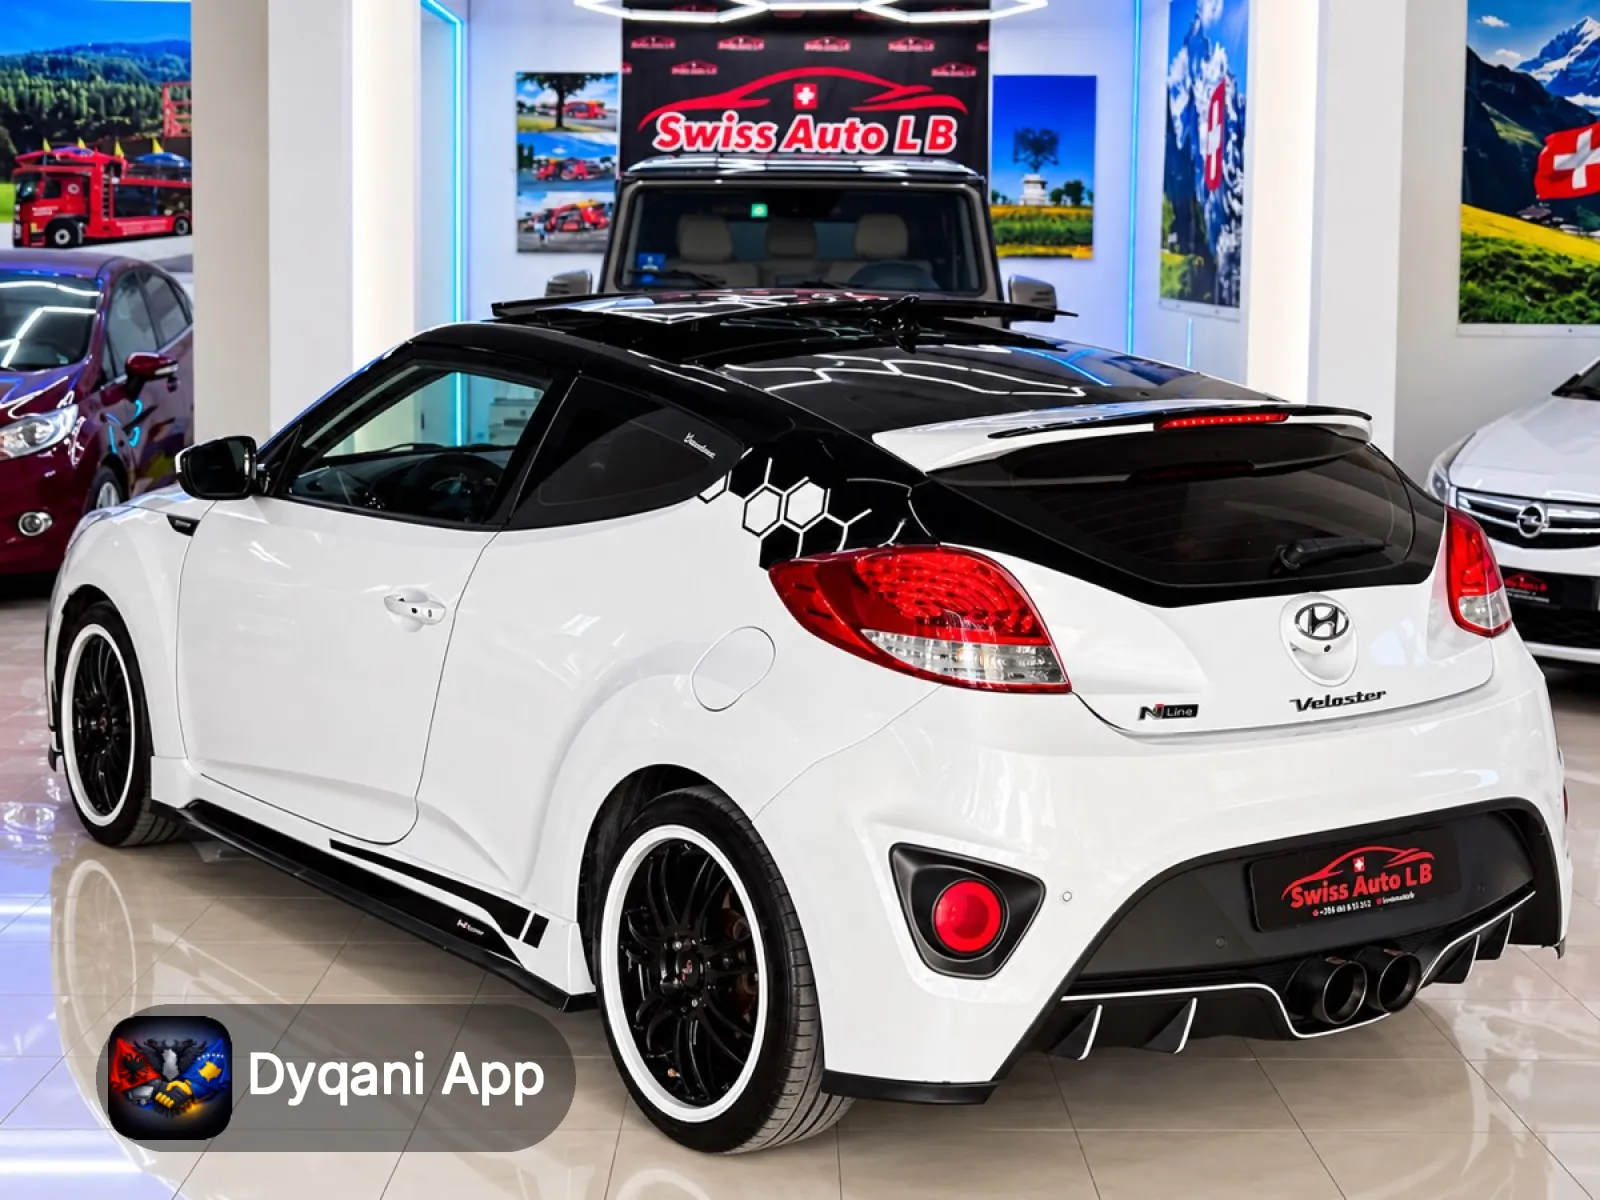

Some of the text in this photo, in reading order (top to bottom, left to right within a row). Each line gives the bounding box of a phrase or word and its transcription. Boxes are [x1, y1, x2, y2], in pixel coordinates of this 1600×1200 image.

[652, 110, 777, 153] Swiss
[779, 114, 889, 153] Auto
[1289, 690, 1387, 713] Veloster
[1290, 880, 1349, 909] Swiss
[1352, 873, 1401, 897] Auto
